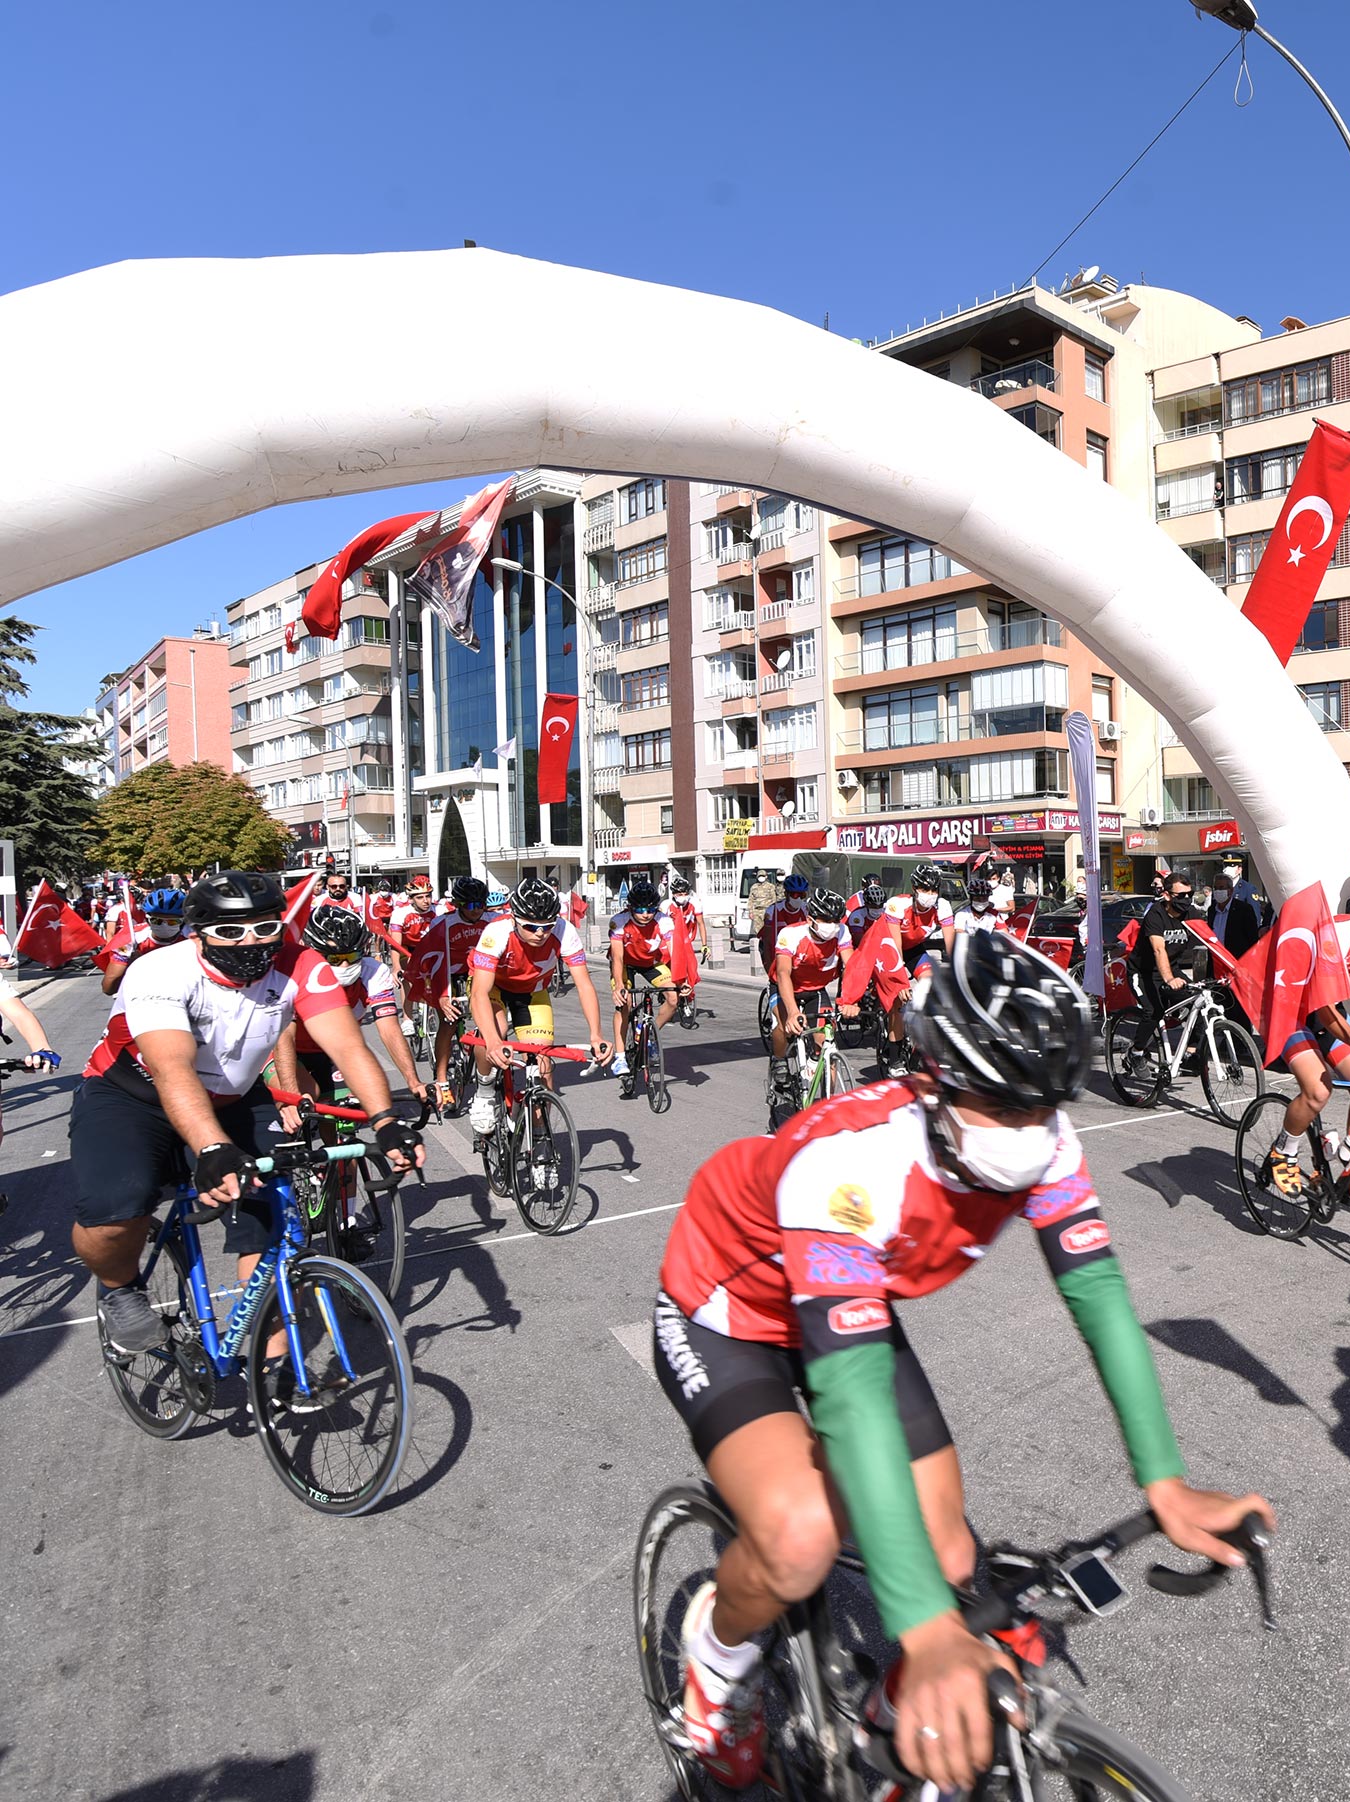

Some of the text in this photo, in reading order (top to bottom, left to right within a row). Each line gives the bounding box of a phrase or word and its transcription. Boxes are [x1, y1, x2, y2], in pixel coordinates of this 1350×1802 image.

[839, 832, 864, 848] ANIT
[865, 823, 922, 849] KAPALI
[611, 851, 631, 861] BOSCH
